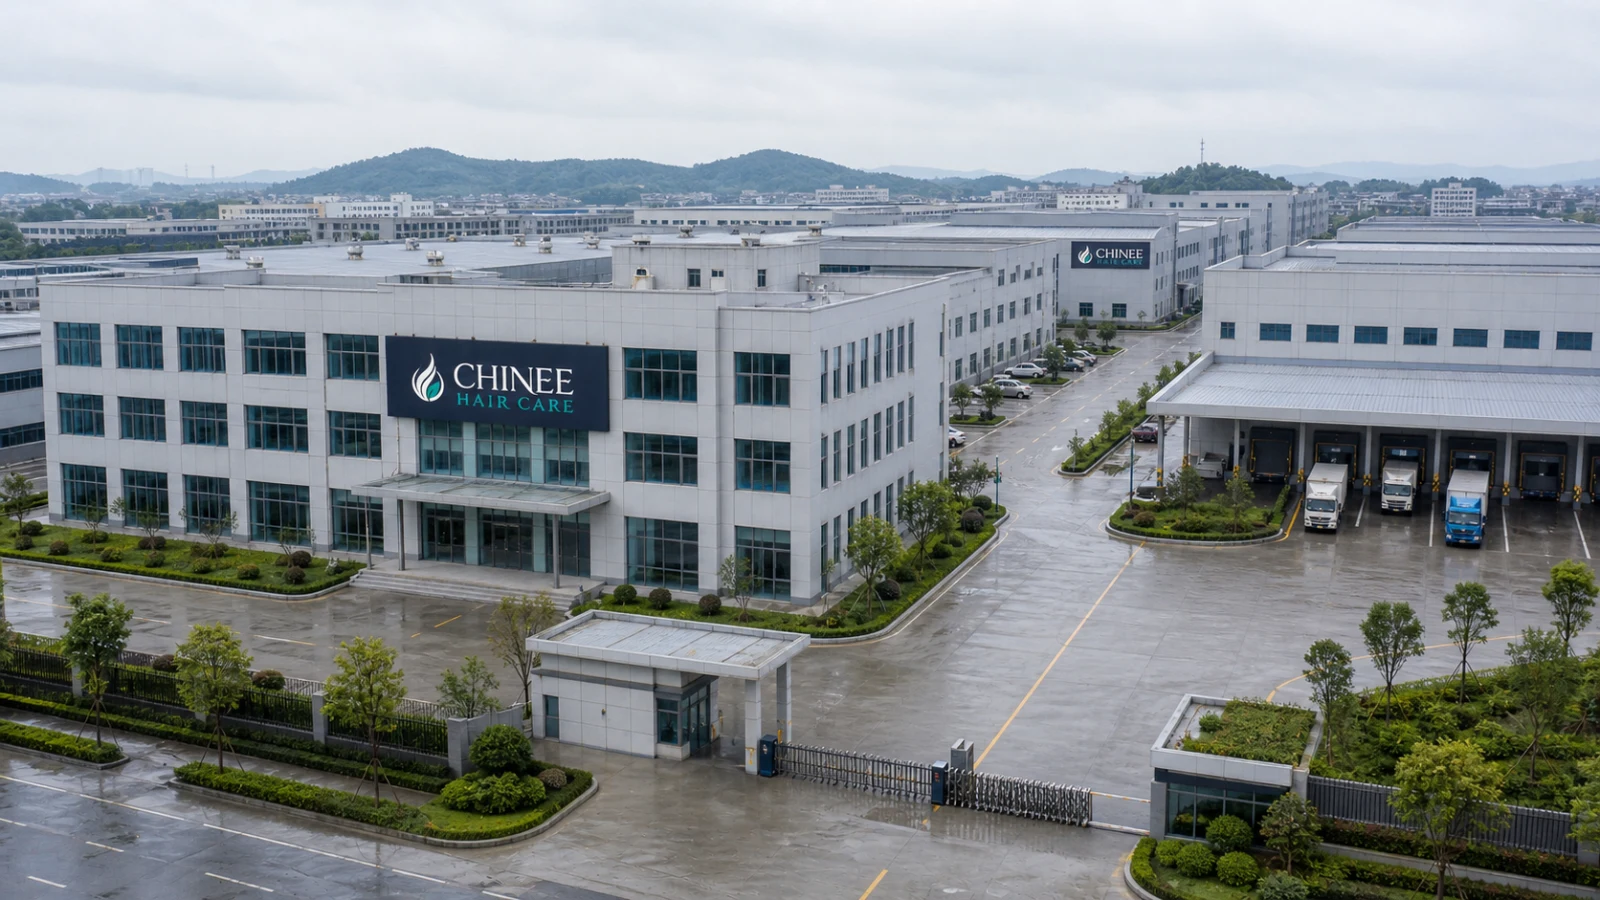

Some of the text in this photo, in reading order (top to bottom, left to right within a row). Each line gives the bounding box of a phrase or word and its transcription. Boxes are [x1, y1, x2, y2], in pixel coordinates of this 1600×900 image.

[1096, 248, 1143, 259] CHINEE
[454, 363, 574, 395] CHINEE
[457, 392, 574, 413] HAIR CARE
